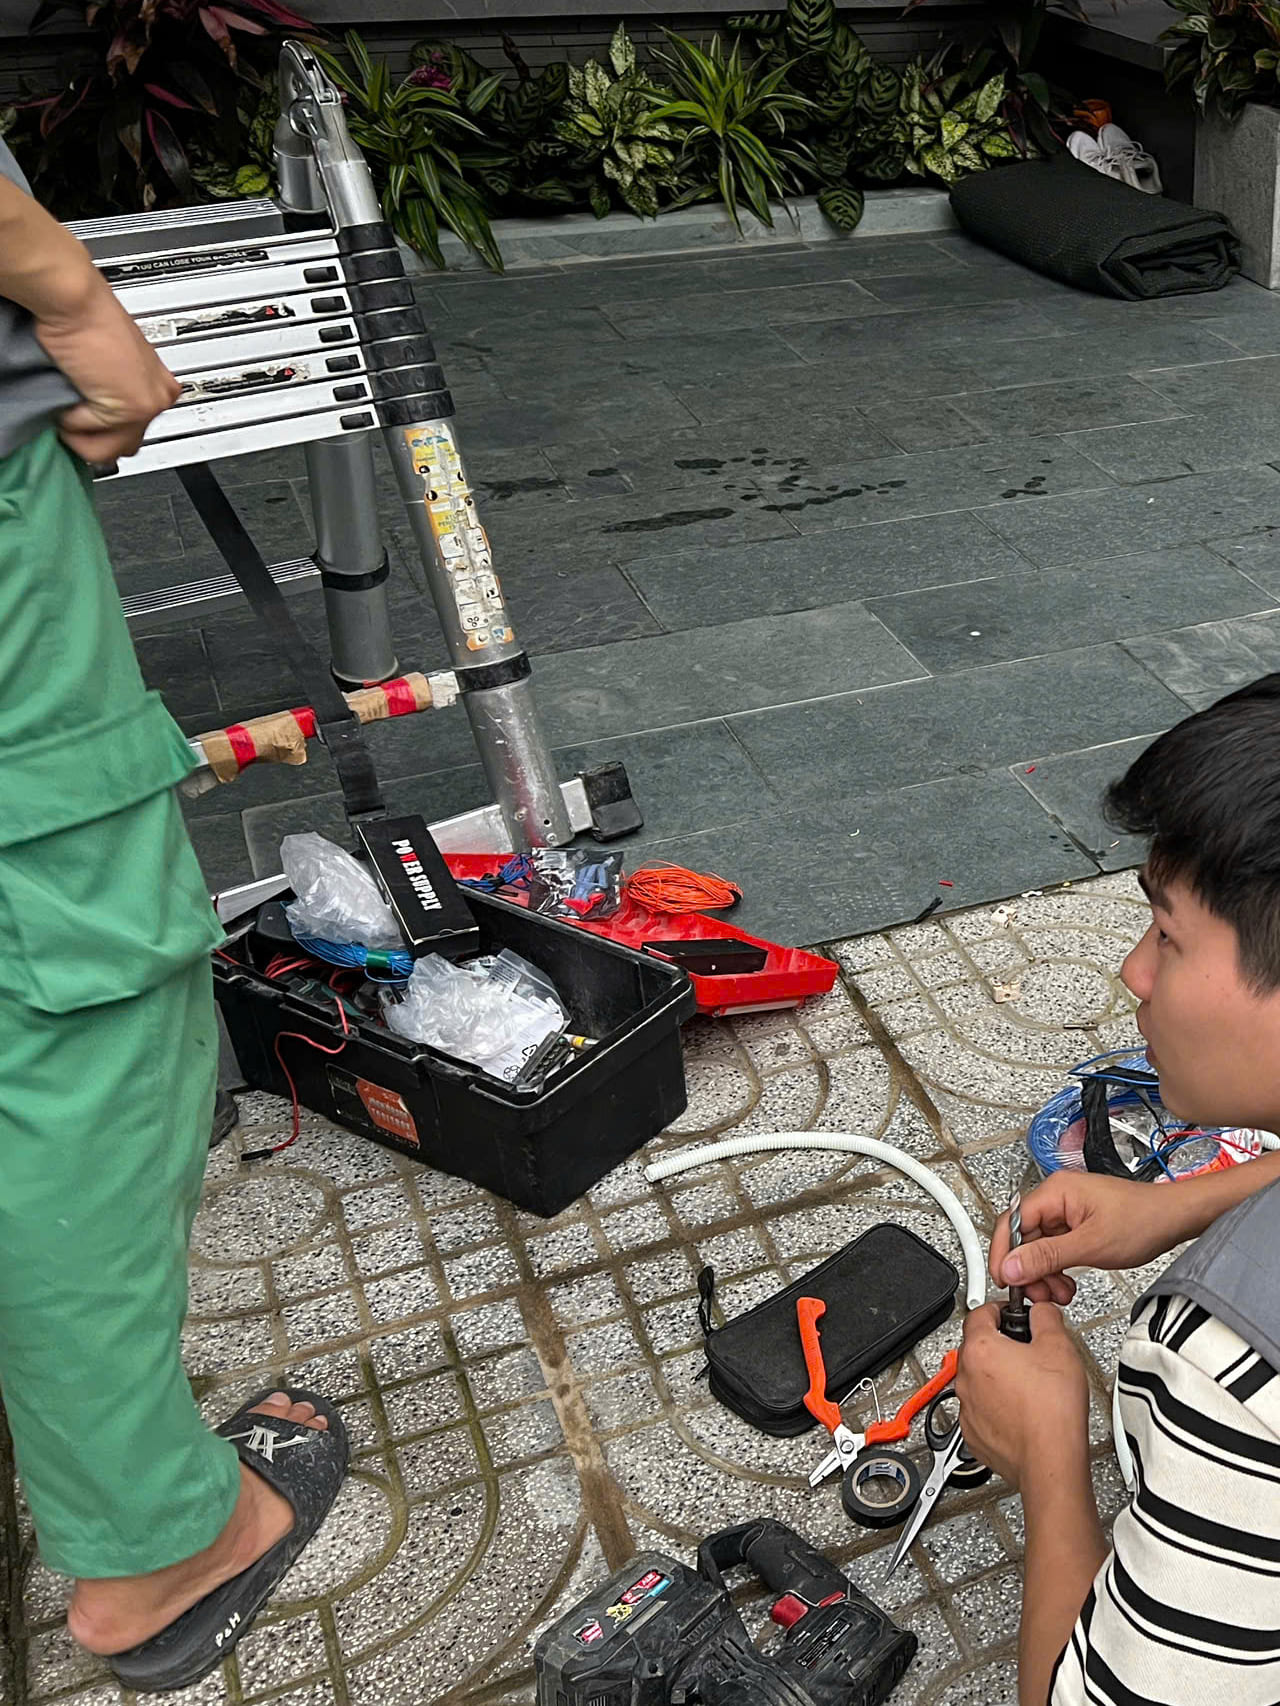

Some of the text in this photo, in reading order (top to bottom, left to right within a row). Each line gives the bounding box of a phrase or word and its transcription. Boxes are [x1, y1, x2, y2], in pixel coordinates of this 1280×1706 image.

[152, 261, 169, 269] CAN
[170, 258, 190, 266] LOSE
[191, 255, 212, 264] YOUR
[391, 839, 443, 911] POWER SUPPLY
